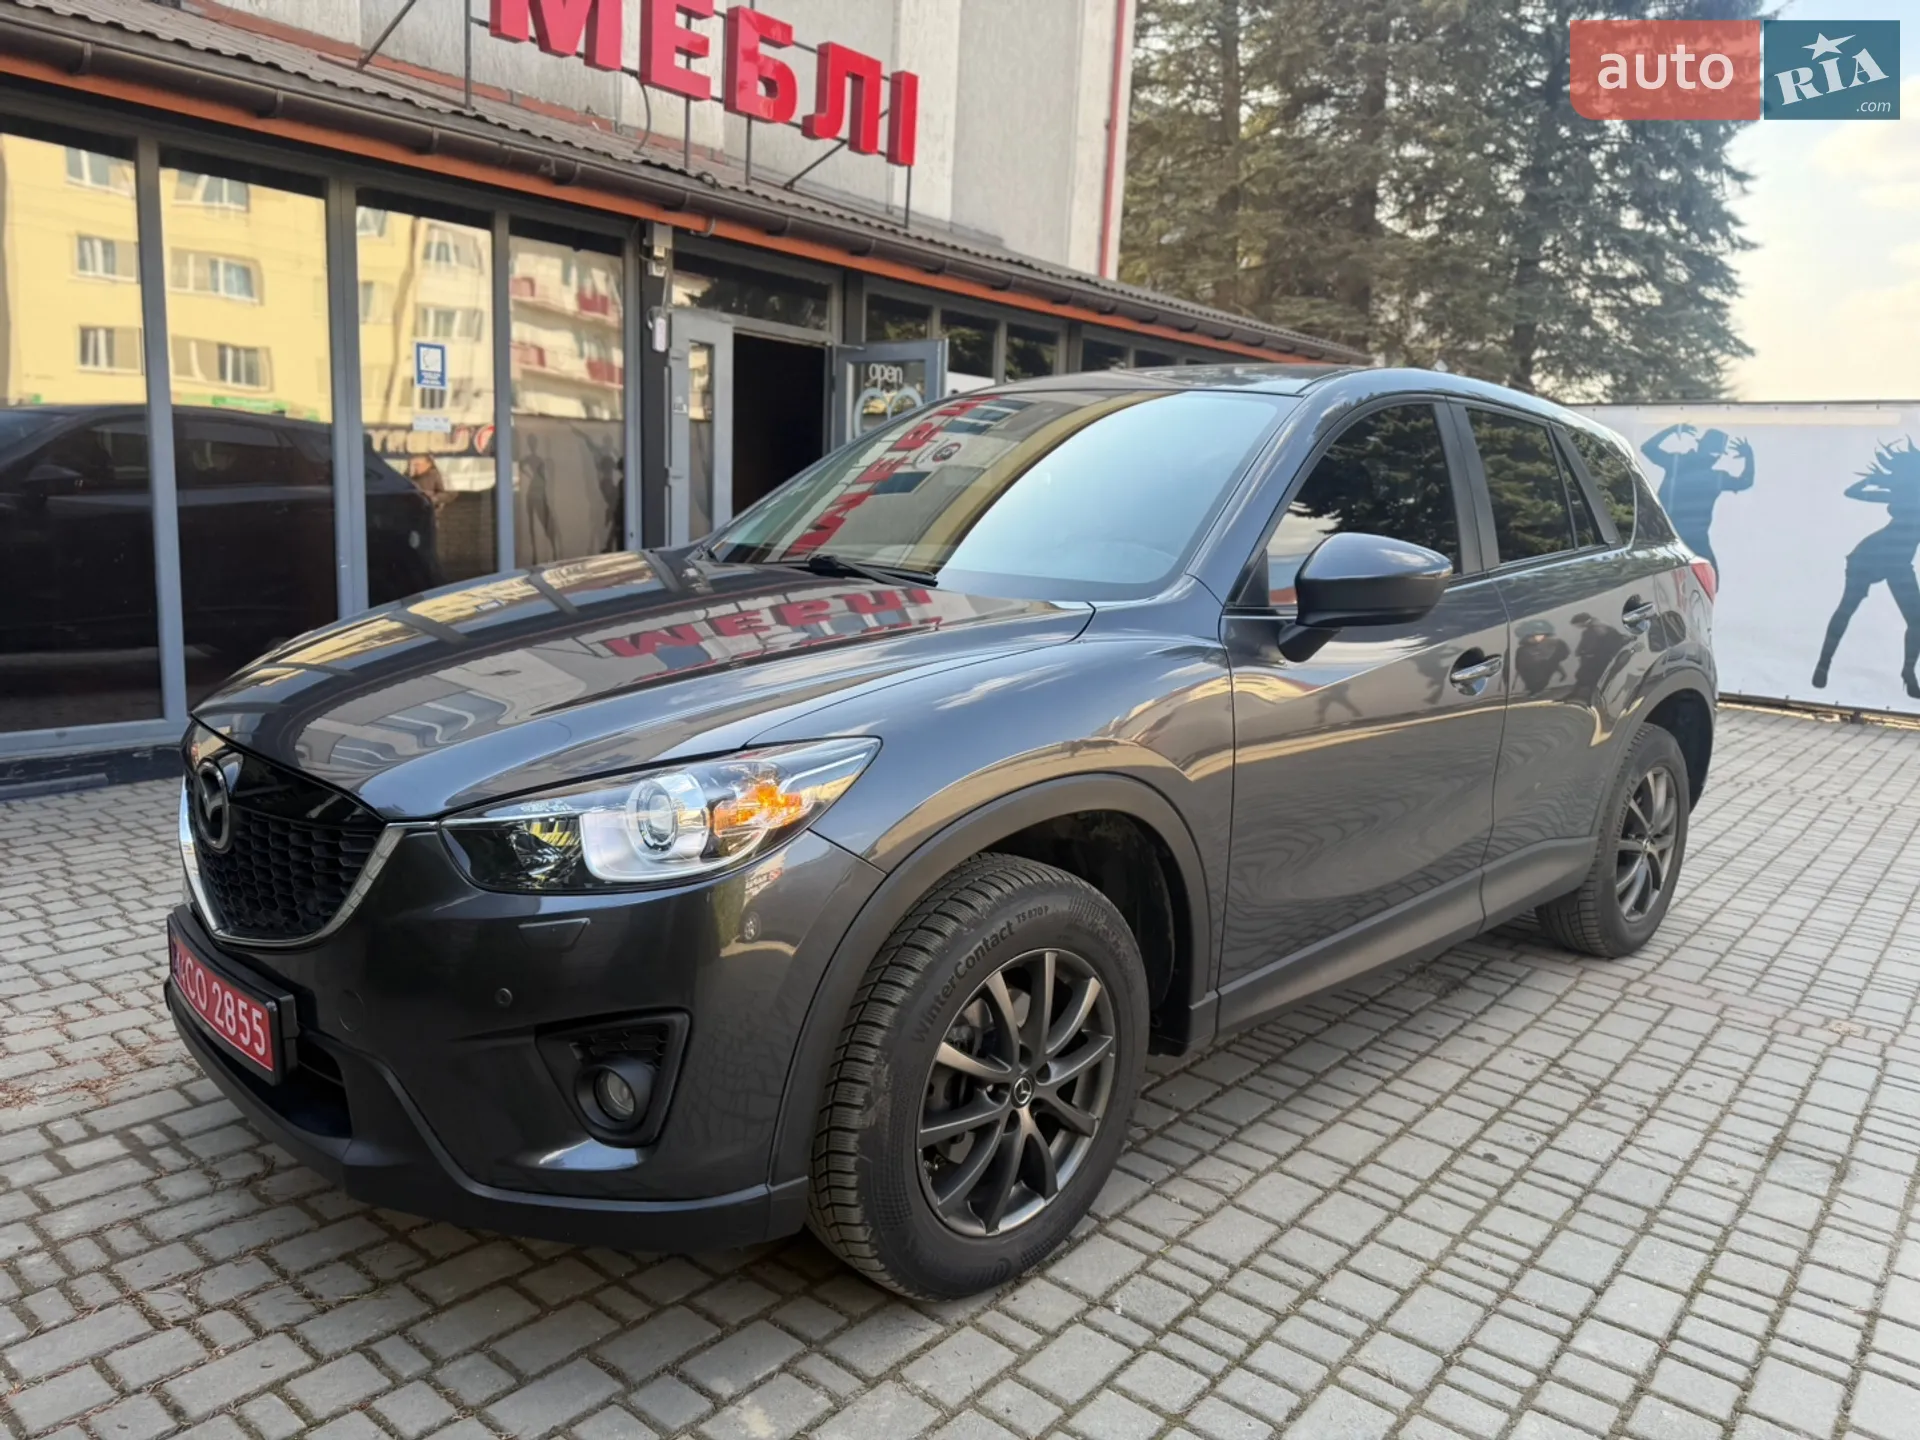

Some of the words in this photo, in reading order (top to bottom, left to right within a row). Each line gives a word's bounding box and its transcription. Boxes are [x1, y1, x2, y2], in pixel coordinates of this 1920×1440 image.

[489, 0, 918, 167] МЕБЛІ
[869, 363, 903, 389] open
[212, 982, 265, 1056] 2855
[911, 920, 1015, 1043] WinterContact
[1015, 914, 1028, 925] TS
